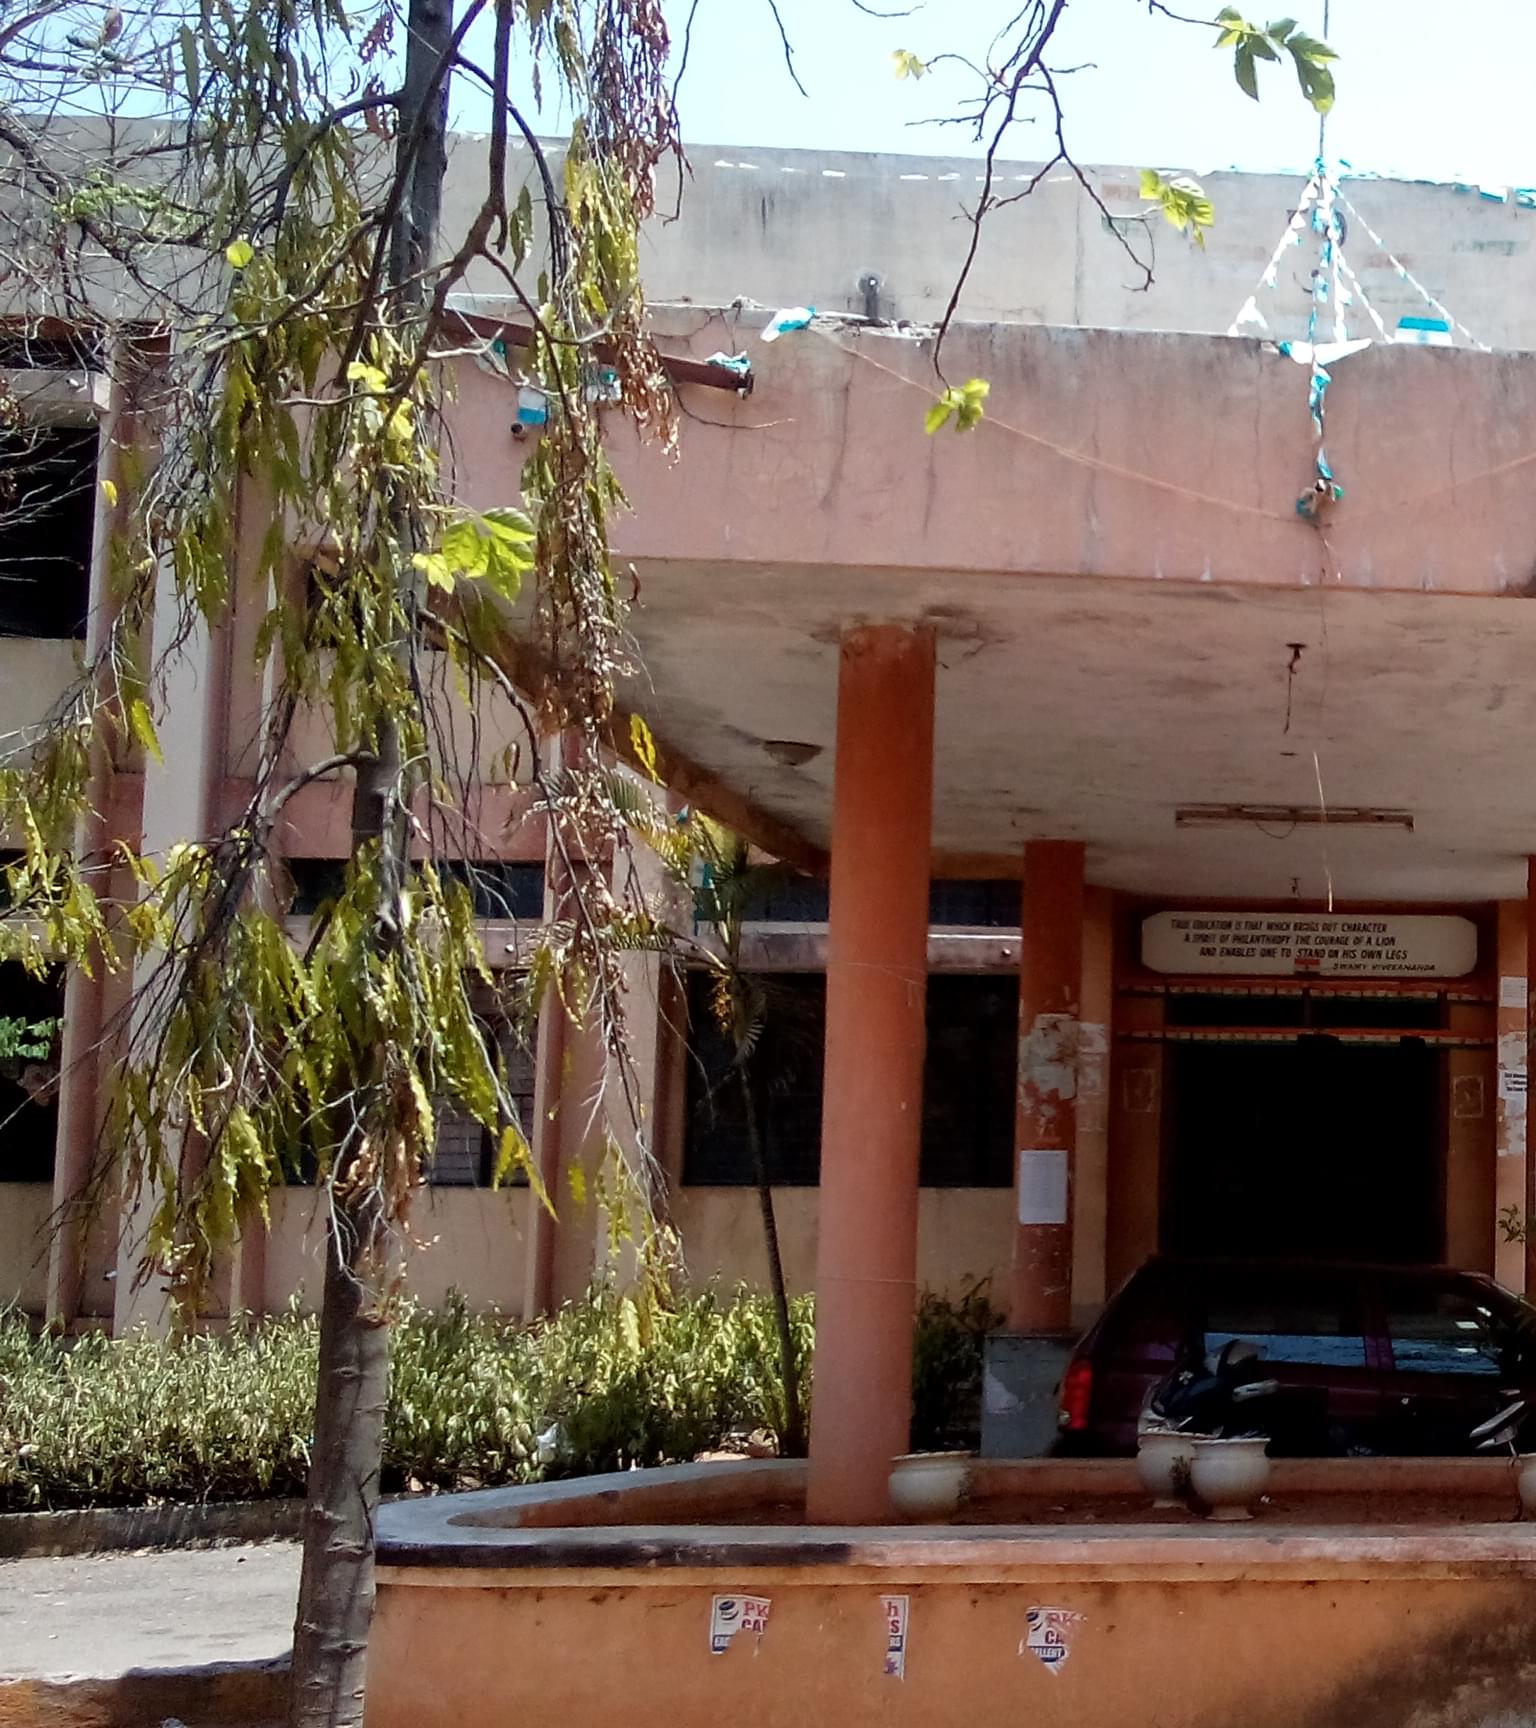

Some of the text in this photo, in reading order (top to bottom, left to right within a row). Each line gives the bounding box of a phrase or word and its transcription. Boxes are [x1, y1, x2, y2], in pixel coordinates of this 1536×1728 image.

[1192, 920, 1232, 930] EDUCATION
[1267, 922, 1290, 931] WHICH
[1322, 923, 1338, 932] OUT
[1341, 923, 1388, 933] CHARACTER
[1184, 934, 1190, 943] A
[1220, 934, 1229, 943] OF
[1232, 934, 1290, 944] PHILANTHROPY
[1296, 935, 1311, 945] THE
[1314, 936, 1349, 946] COURAGE
[1352, 936, 1363, 946] OF
[1366, 936, 1372, 946] A
[1376, 937, 1396, 946] LION
[1200, 947, 1408, 960] AND ENABLES ONE TO STAND ON HIS OWN LEGS
